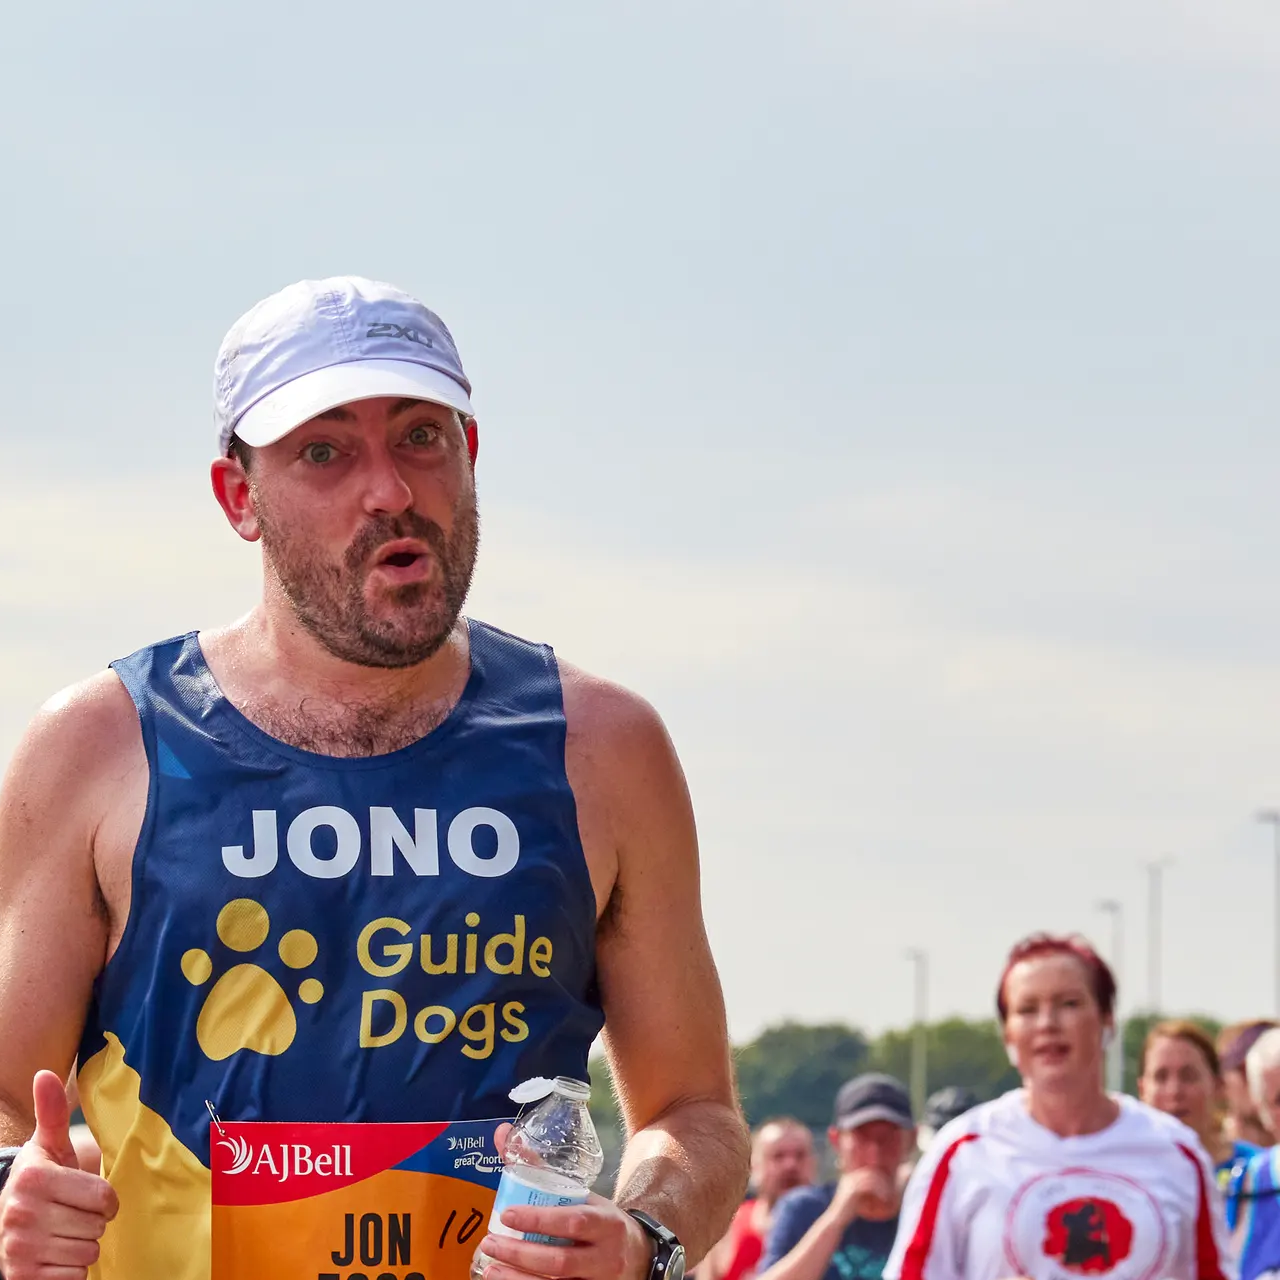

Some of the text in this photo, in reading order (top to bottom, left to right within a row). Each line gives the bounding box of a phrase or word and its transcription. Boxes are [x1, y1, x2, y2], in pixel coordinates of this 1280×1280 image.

[365, 322, 434, 349] 2XU
[221, 805, 521, 879] JONO
[356, 912, 554, 978] Guide
[359, 988, 530, 1060] Dogs
[251, 1144, 354, 1182] AJBell
[454, 1155, 505, 1169] great nort
[455, 1136, 485, 1151] AJBell
[331, 1213, 412, 1267] JON
